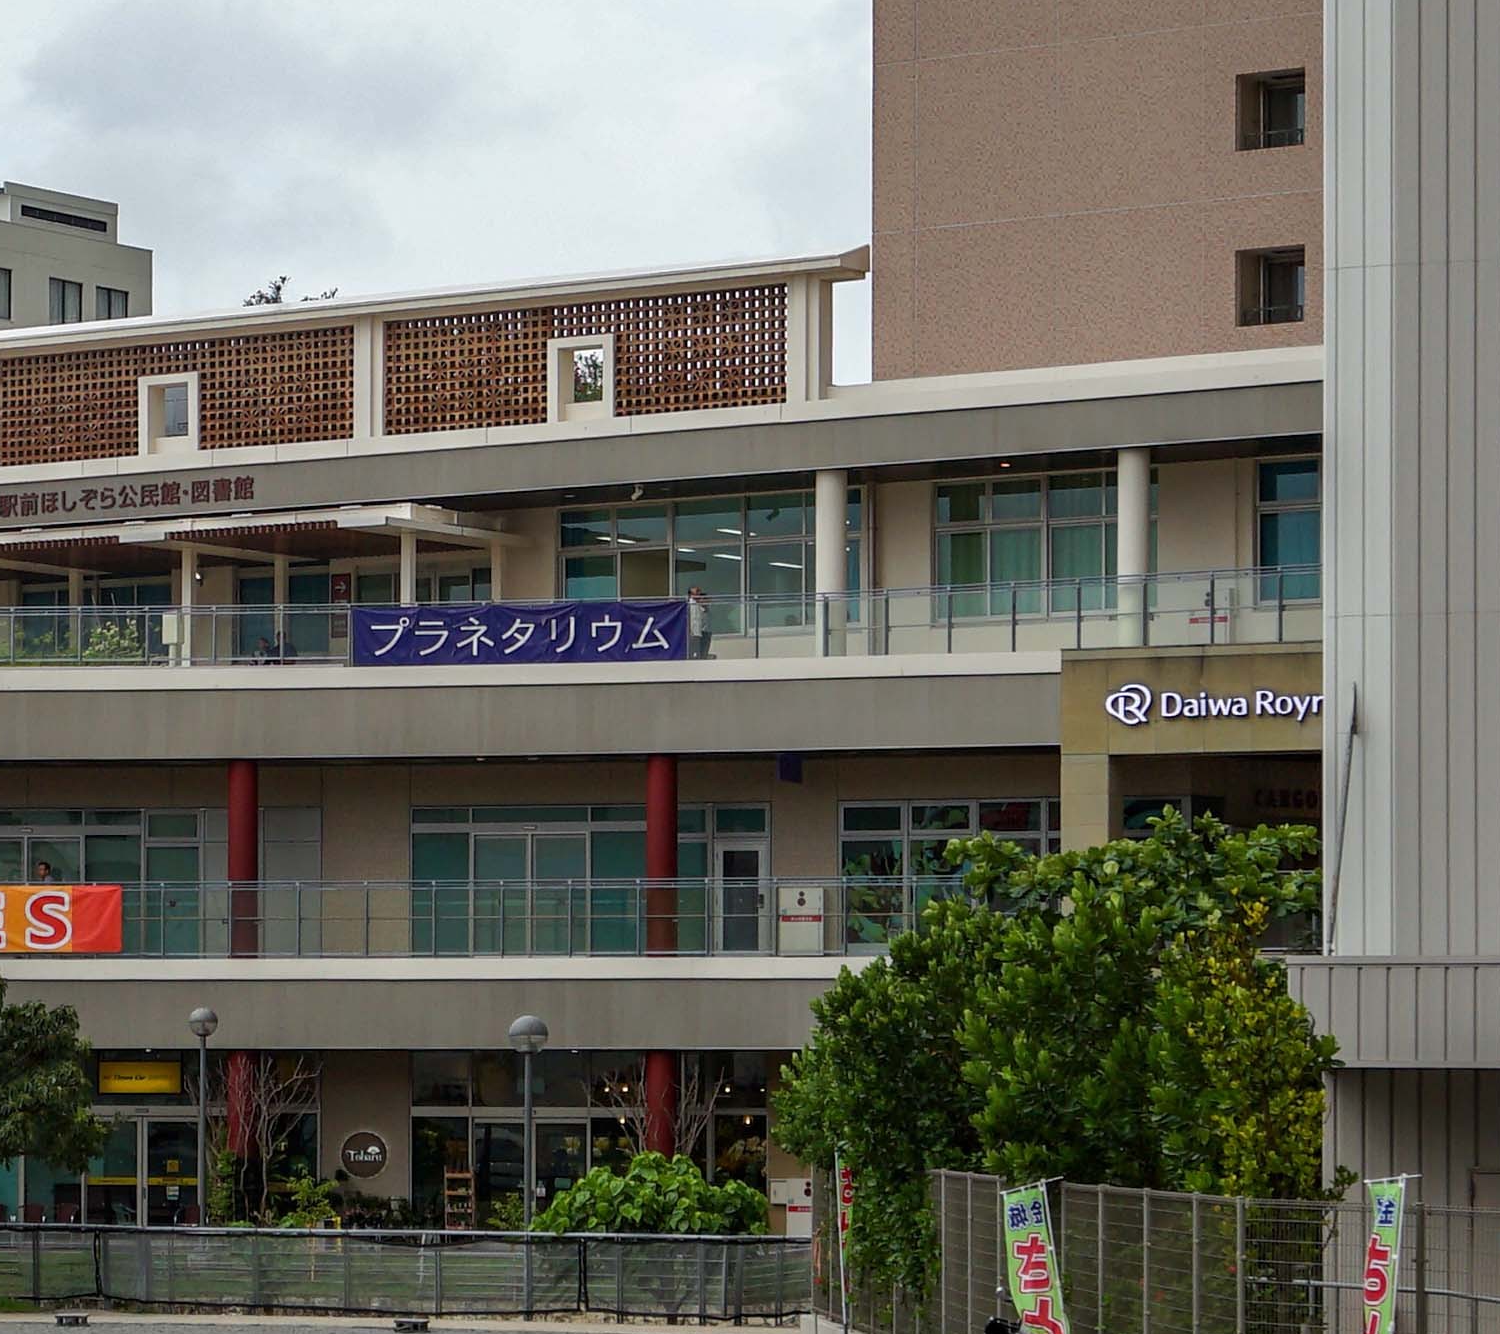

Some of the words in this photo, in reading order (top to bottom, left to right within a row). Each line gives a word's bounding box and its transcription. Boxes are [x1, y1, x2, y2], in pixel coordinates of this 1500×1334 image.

[370, 615, 671, 657] プラネタリウム
[1160, 691, 1248, 718] Daiwa
